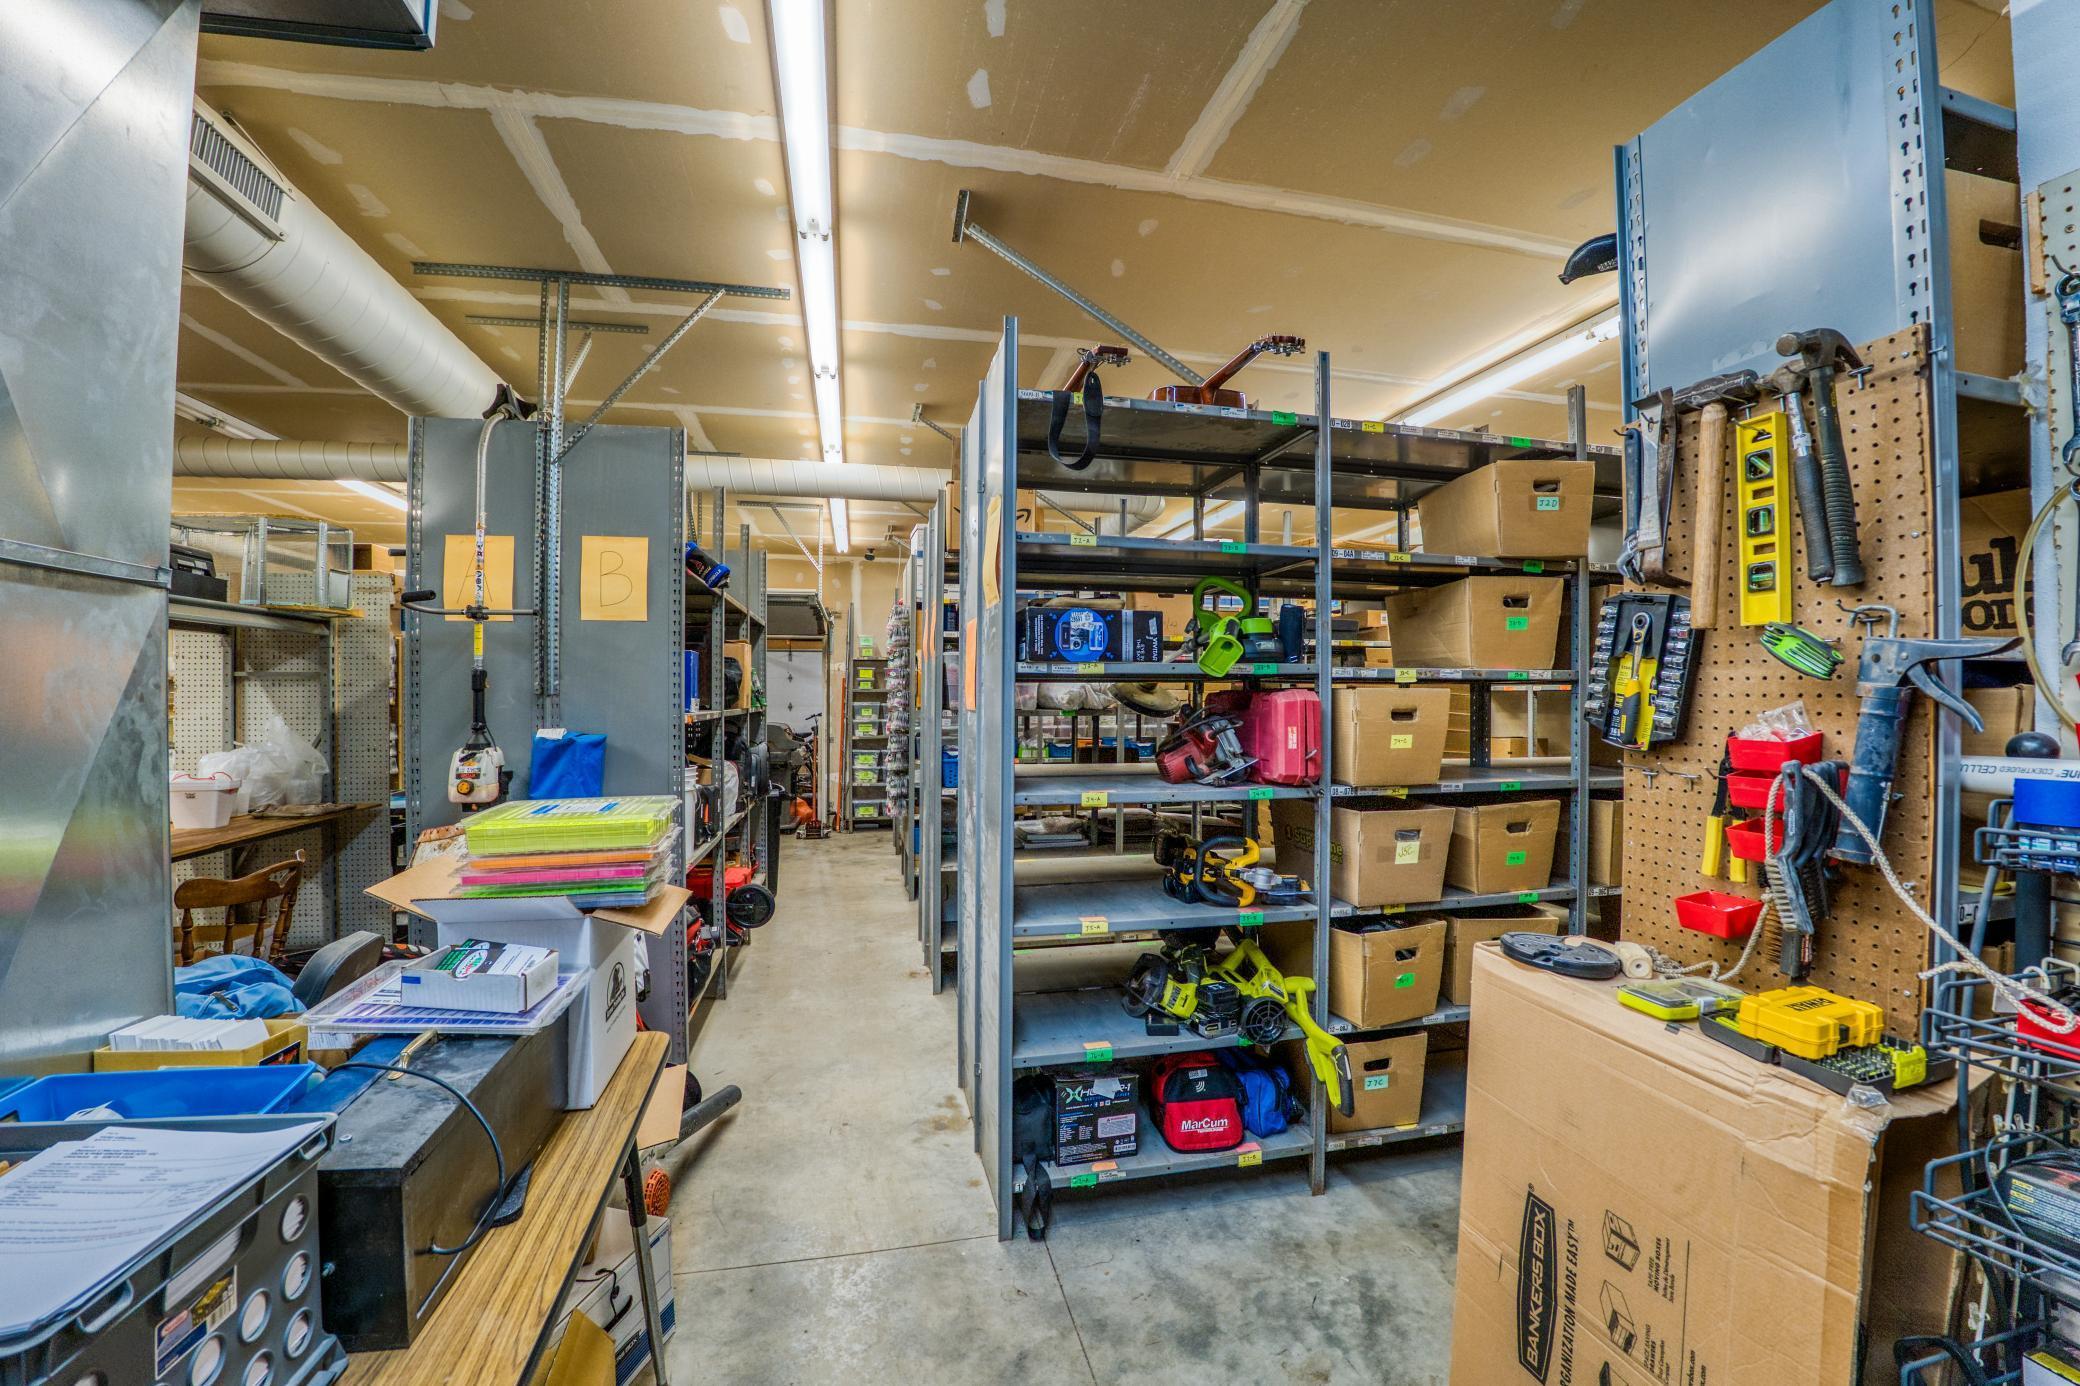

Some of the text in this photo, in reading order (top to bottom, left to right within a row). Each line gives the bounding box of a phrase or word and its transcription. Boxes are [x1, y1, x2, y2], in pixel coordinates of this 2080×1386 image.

[1539, 498, 1558, 508] J2D
[457, 548, 493, 604] A
[600, 551, 633, 607] B
[1367, 1078, 1384, 1088] J7C
[1181, 1117, 1229, 1131] MarCum
[1526, 1206, 1546, 1368] BANKERS BOX
[1564, 1267, 1577, 1306] MADE
[1653, 1262, 1662, 1293] MOVING
